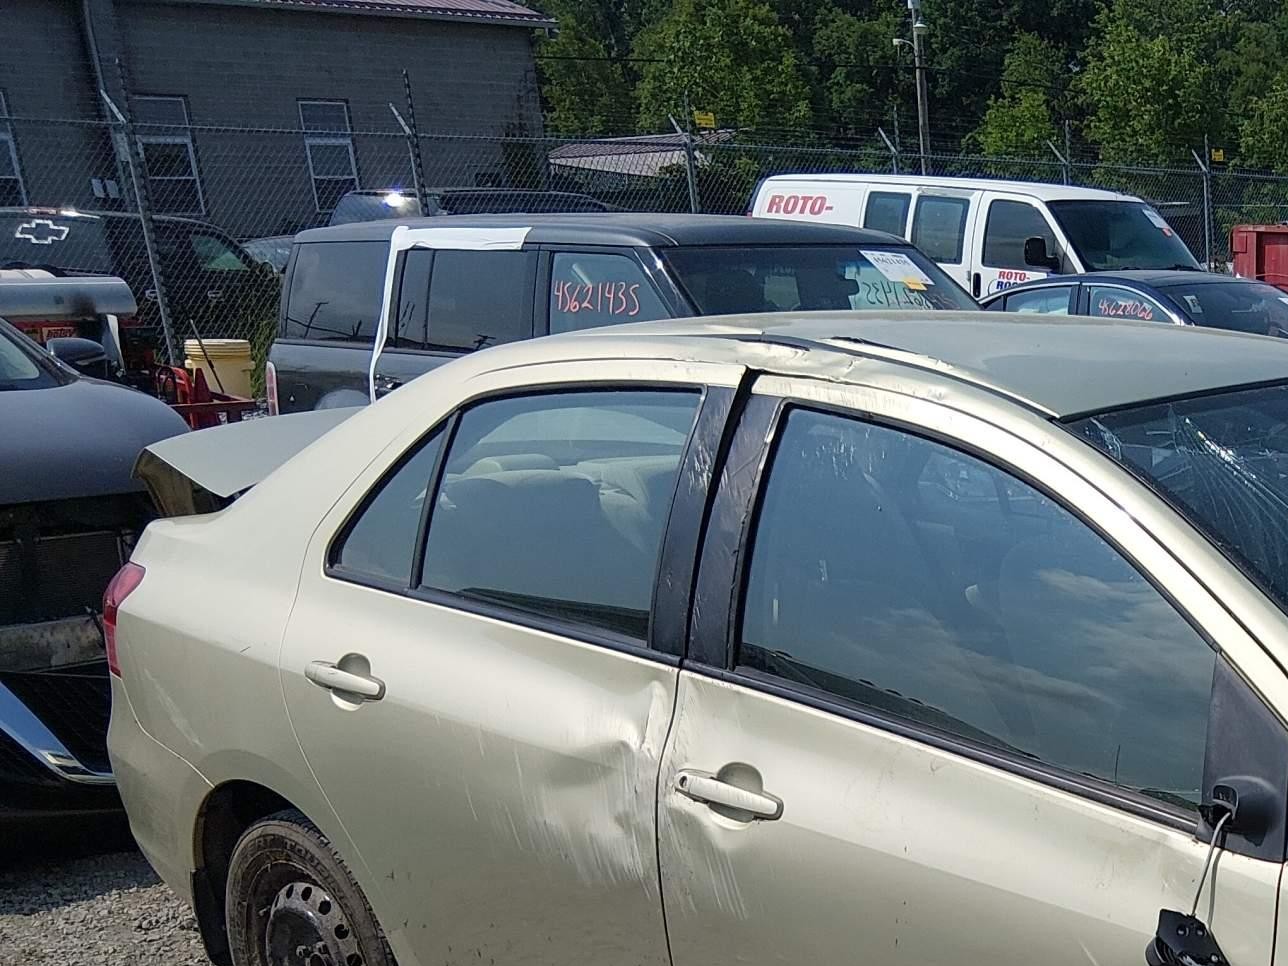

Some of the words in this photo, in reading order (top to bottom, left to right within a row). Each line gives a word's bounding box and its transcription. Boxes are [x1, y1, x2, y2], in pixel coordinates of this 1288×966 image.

[766, 194, 834, 216] ROTO-
[998, 270, 1031, 282] ROTO-
[553, 279, 640, 316] 45621435
